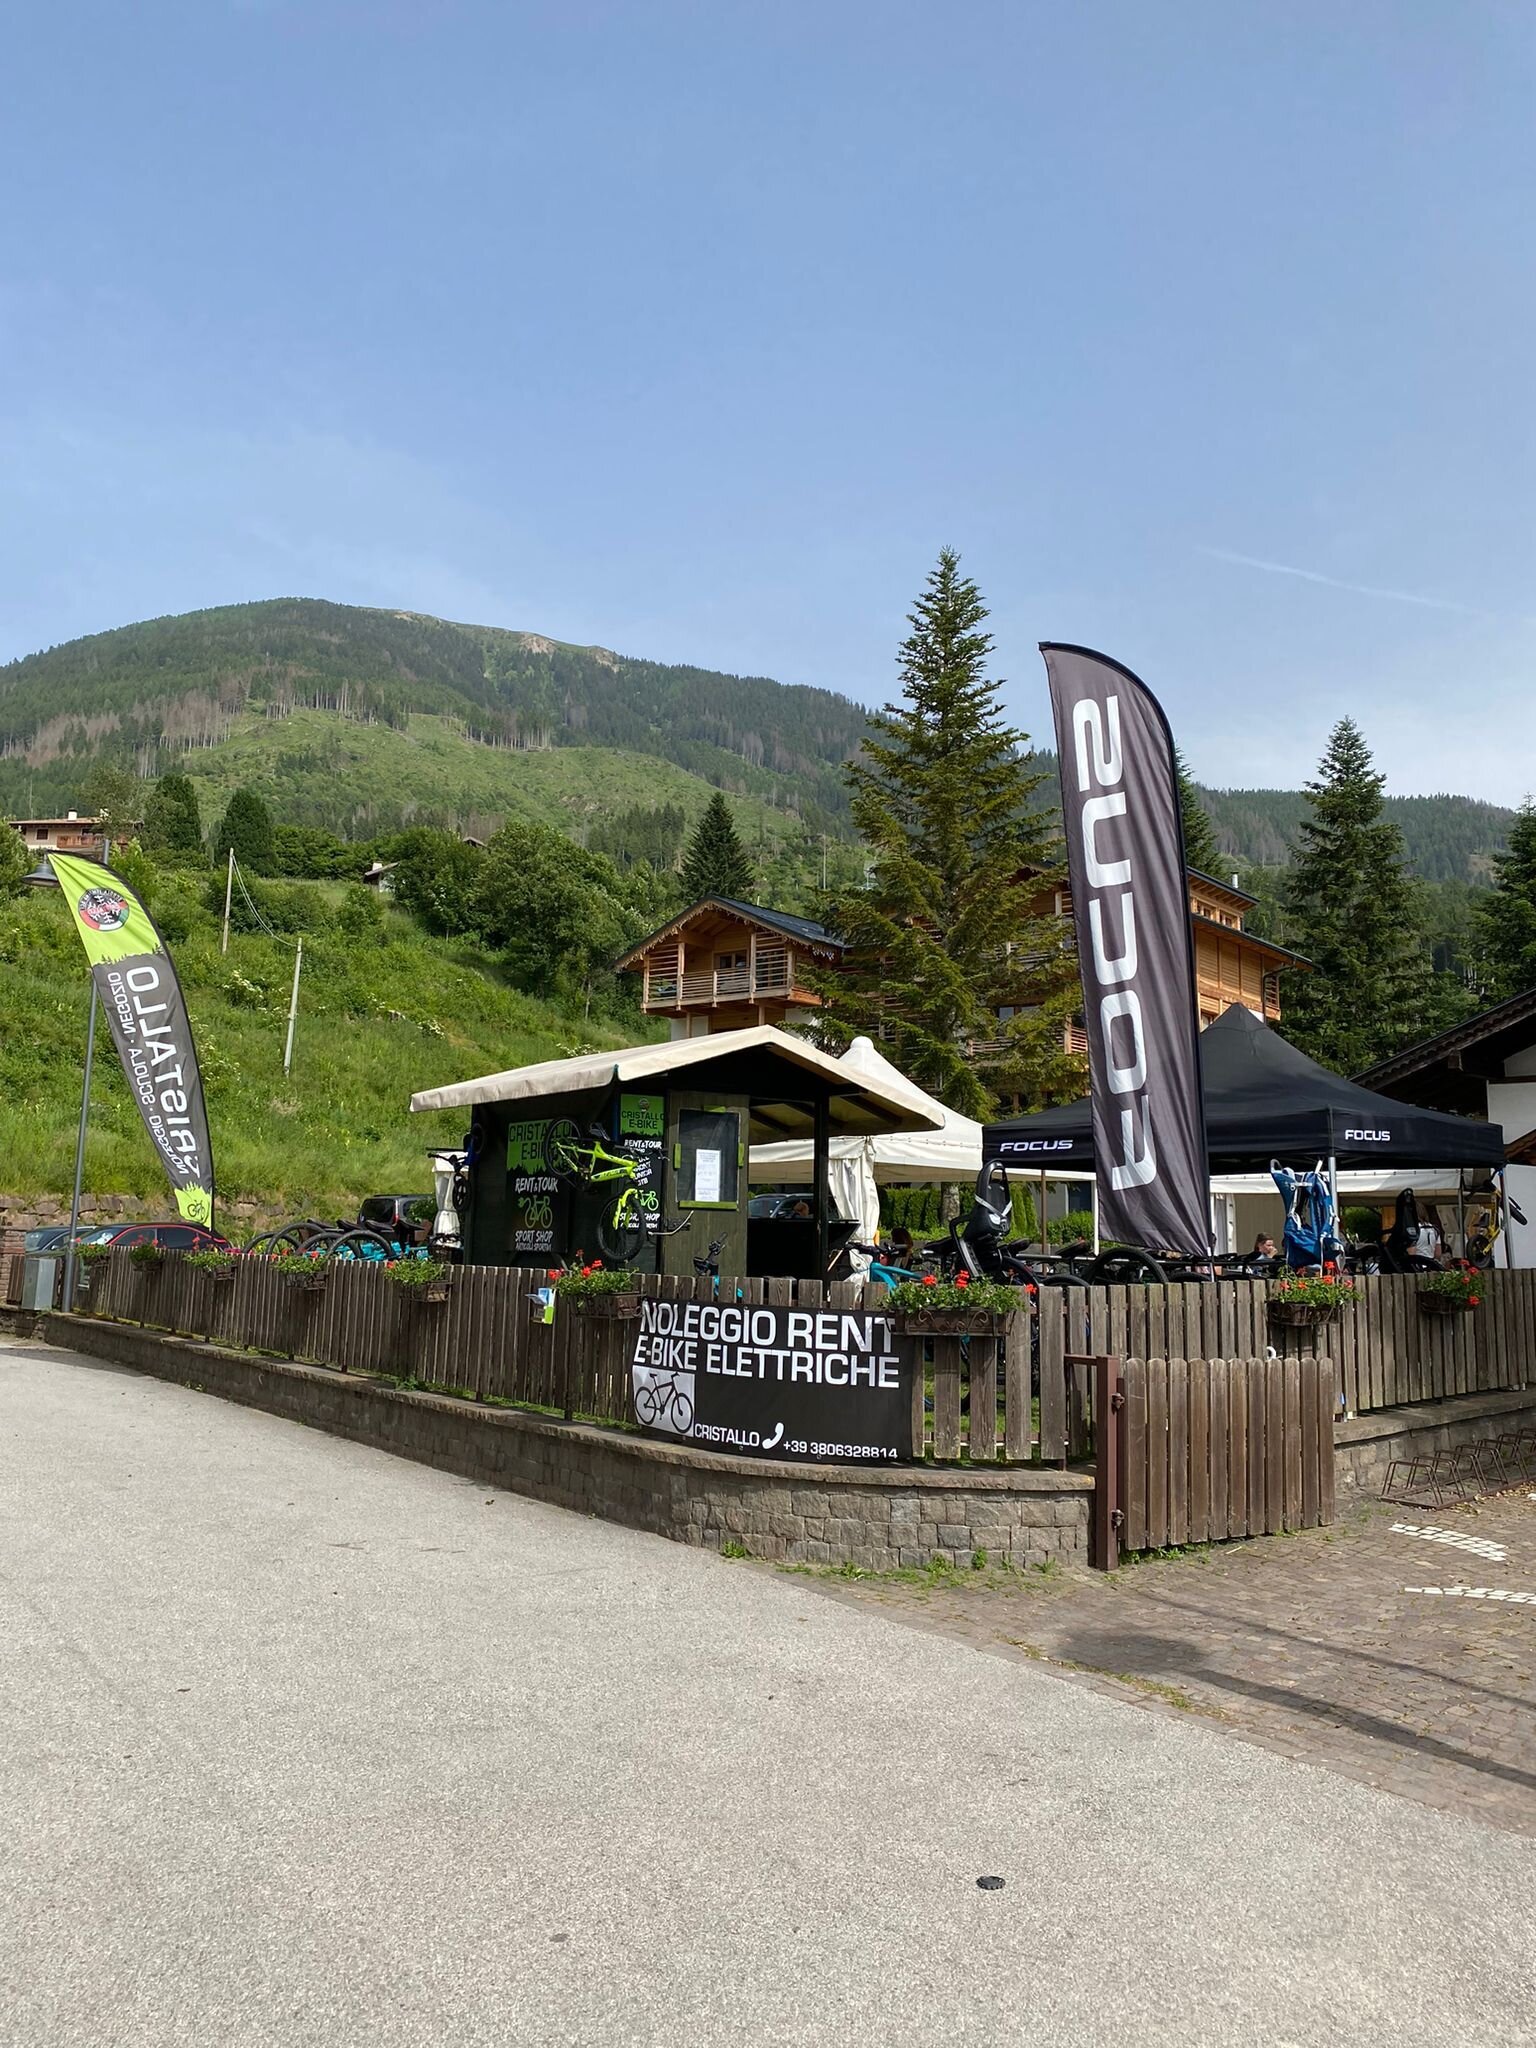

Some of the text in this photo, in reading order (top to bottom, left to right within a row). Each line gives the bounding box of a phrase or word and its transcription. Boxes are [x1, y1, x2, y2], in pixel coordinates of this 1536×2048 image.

[622, 1110, 665, 1121] CRISTALLO
[629, 1119, 658, 1129] E-BIKE
[1345, 1129, 1391, 1141] FOCUS
[1000, 1140, 1073, 1152] FOCUS
[515, 1230, 553, 1243] SPORT SHOP
[640, 1301, 896, 1353] NOLEGGIO RENT
[634, 1335, 900, 1388] E-BIKE ELETTRICHE
[694, 1423, 898, 1459] CRISTALLO +39 3806328814
